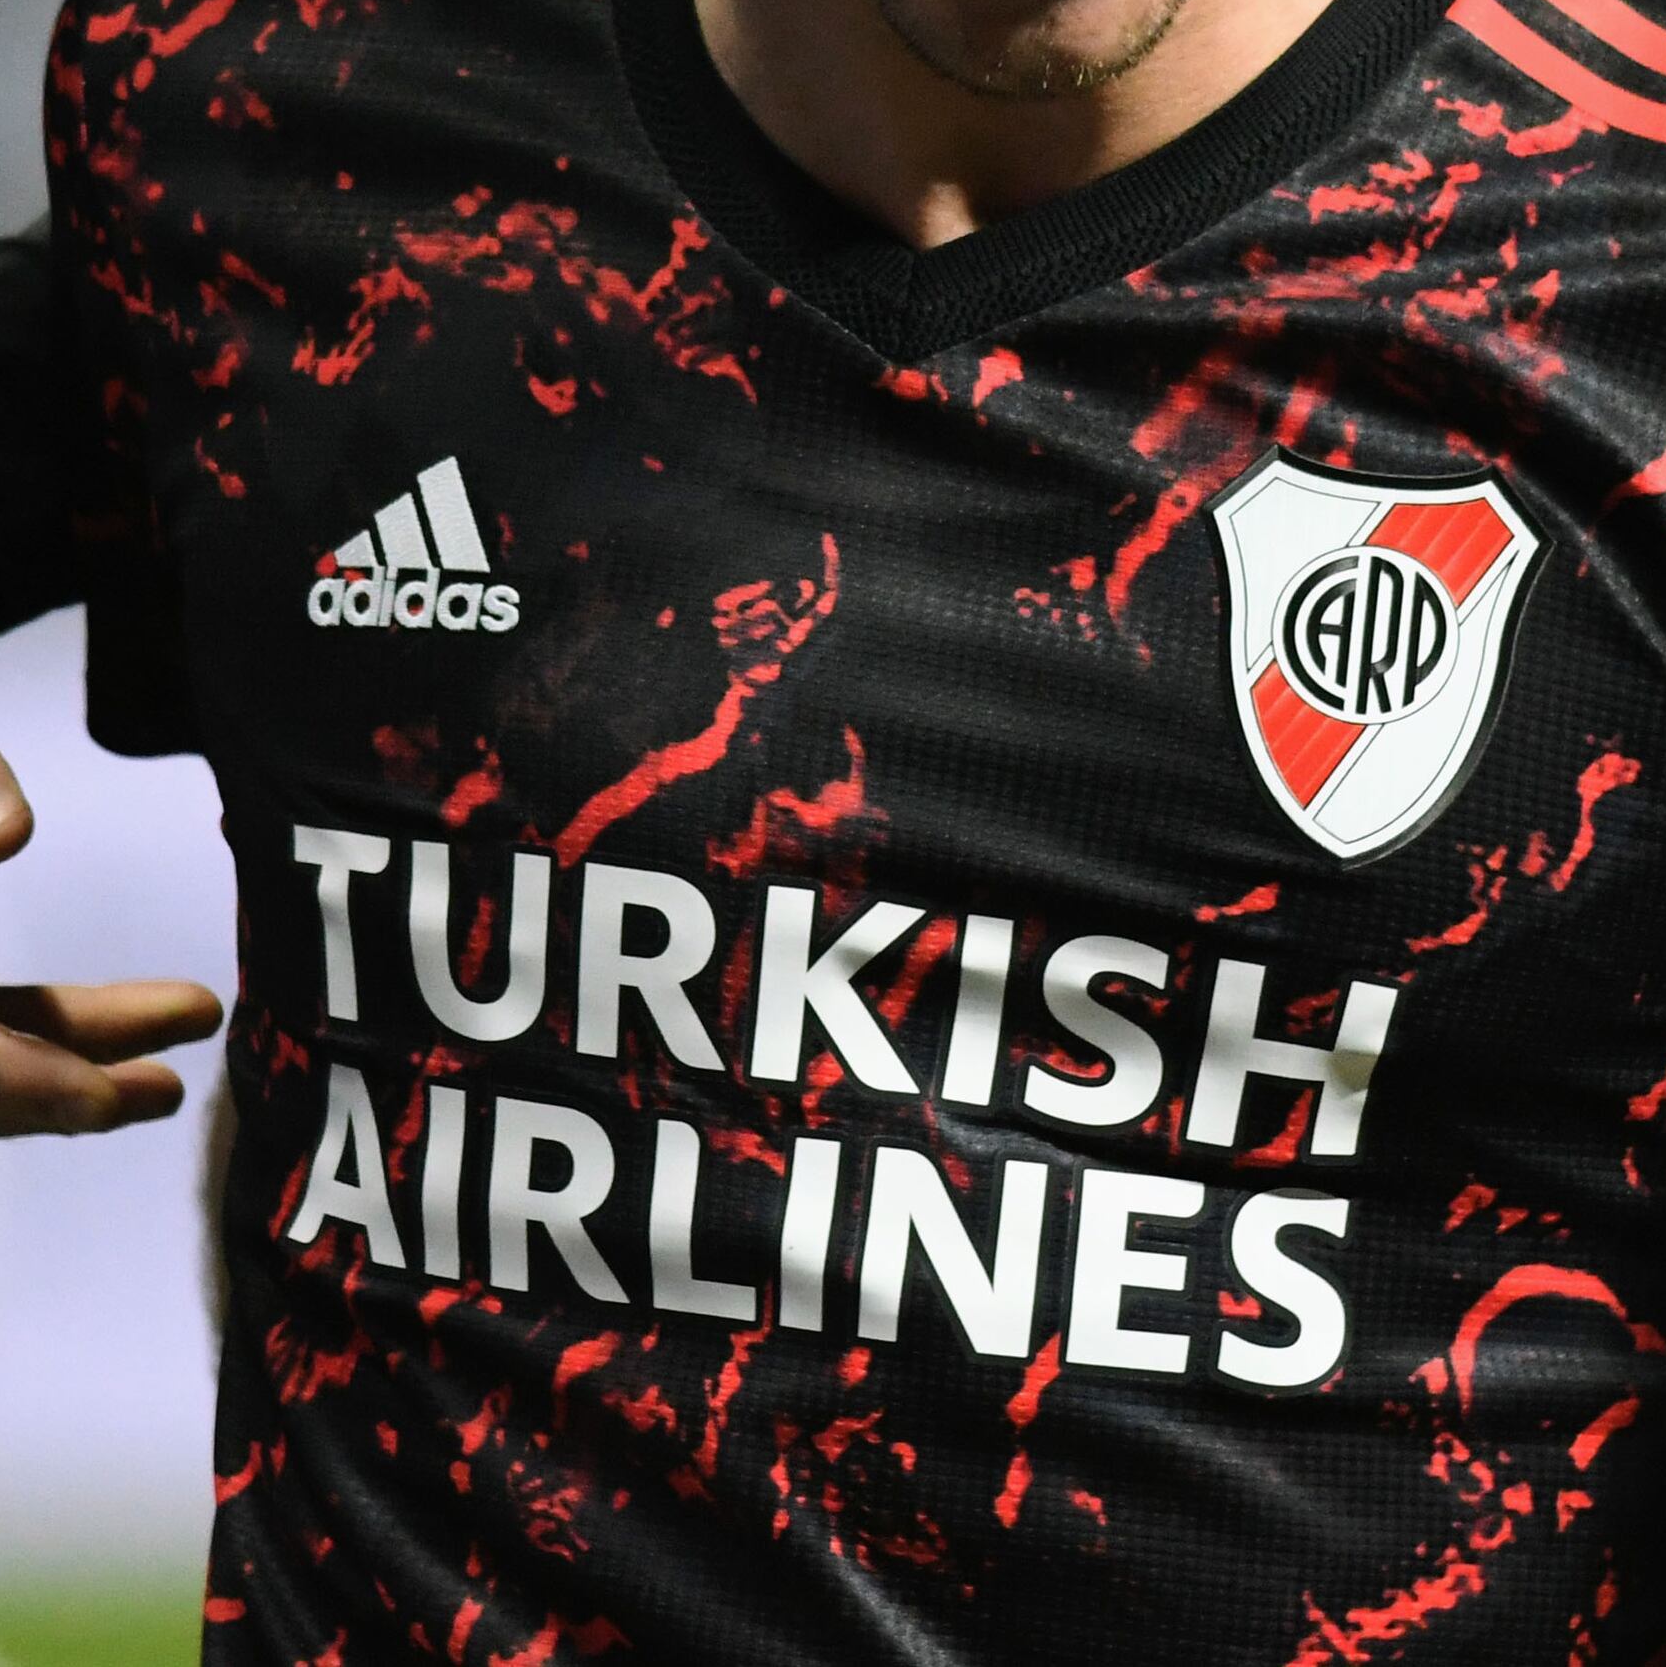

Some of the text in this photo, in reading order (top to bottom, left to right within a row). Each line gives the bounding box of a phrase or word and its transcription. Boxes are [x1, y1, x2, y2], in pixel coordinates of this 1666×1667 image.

[307, 565, 520, 632] adidas
[293, 824, 1398, 1156] TURKISH
[286, 1068, 1349, 1388] AIRLINES
